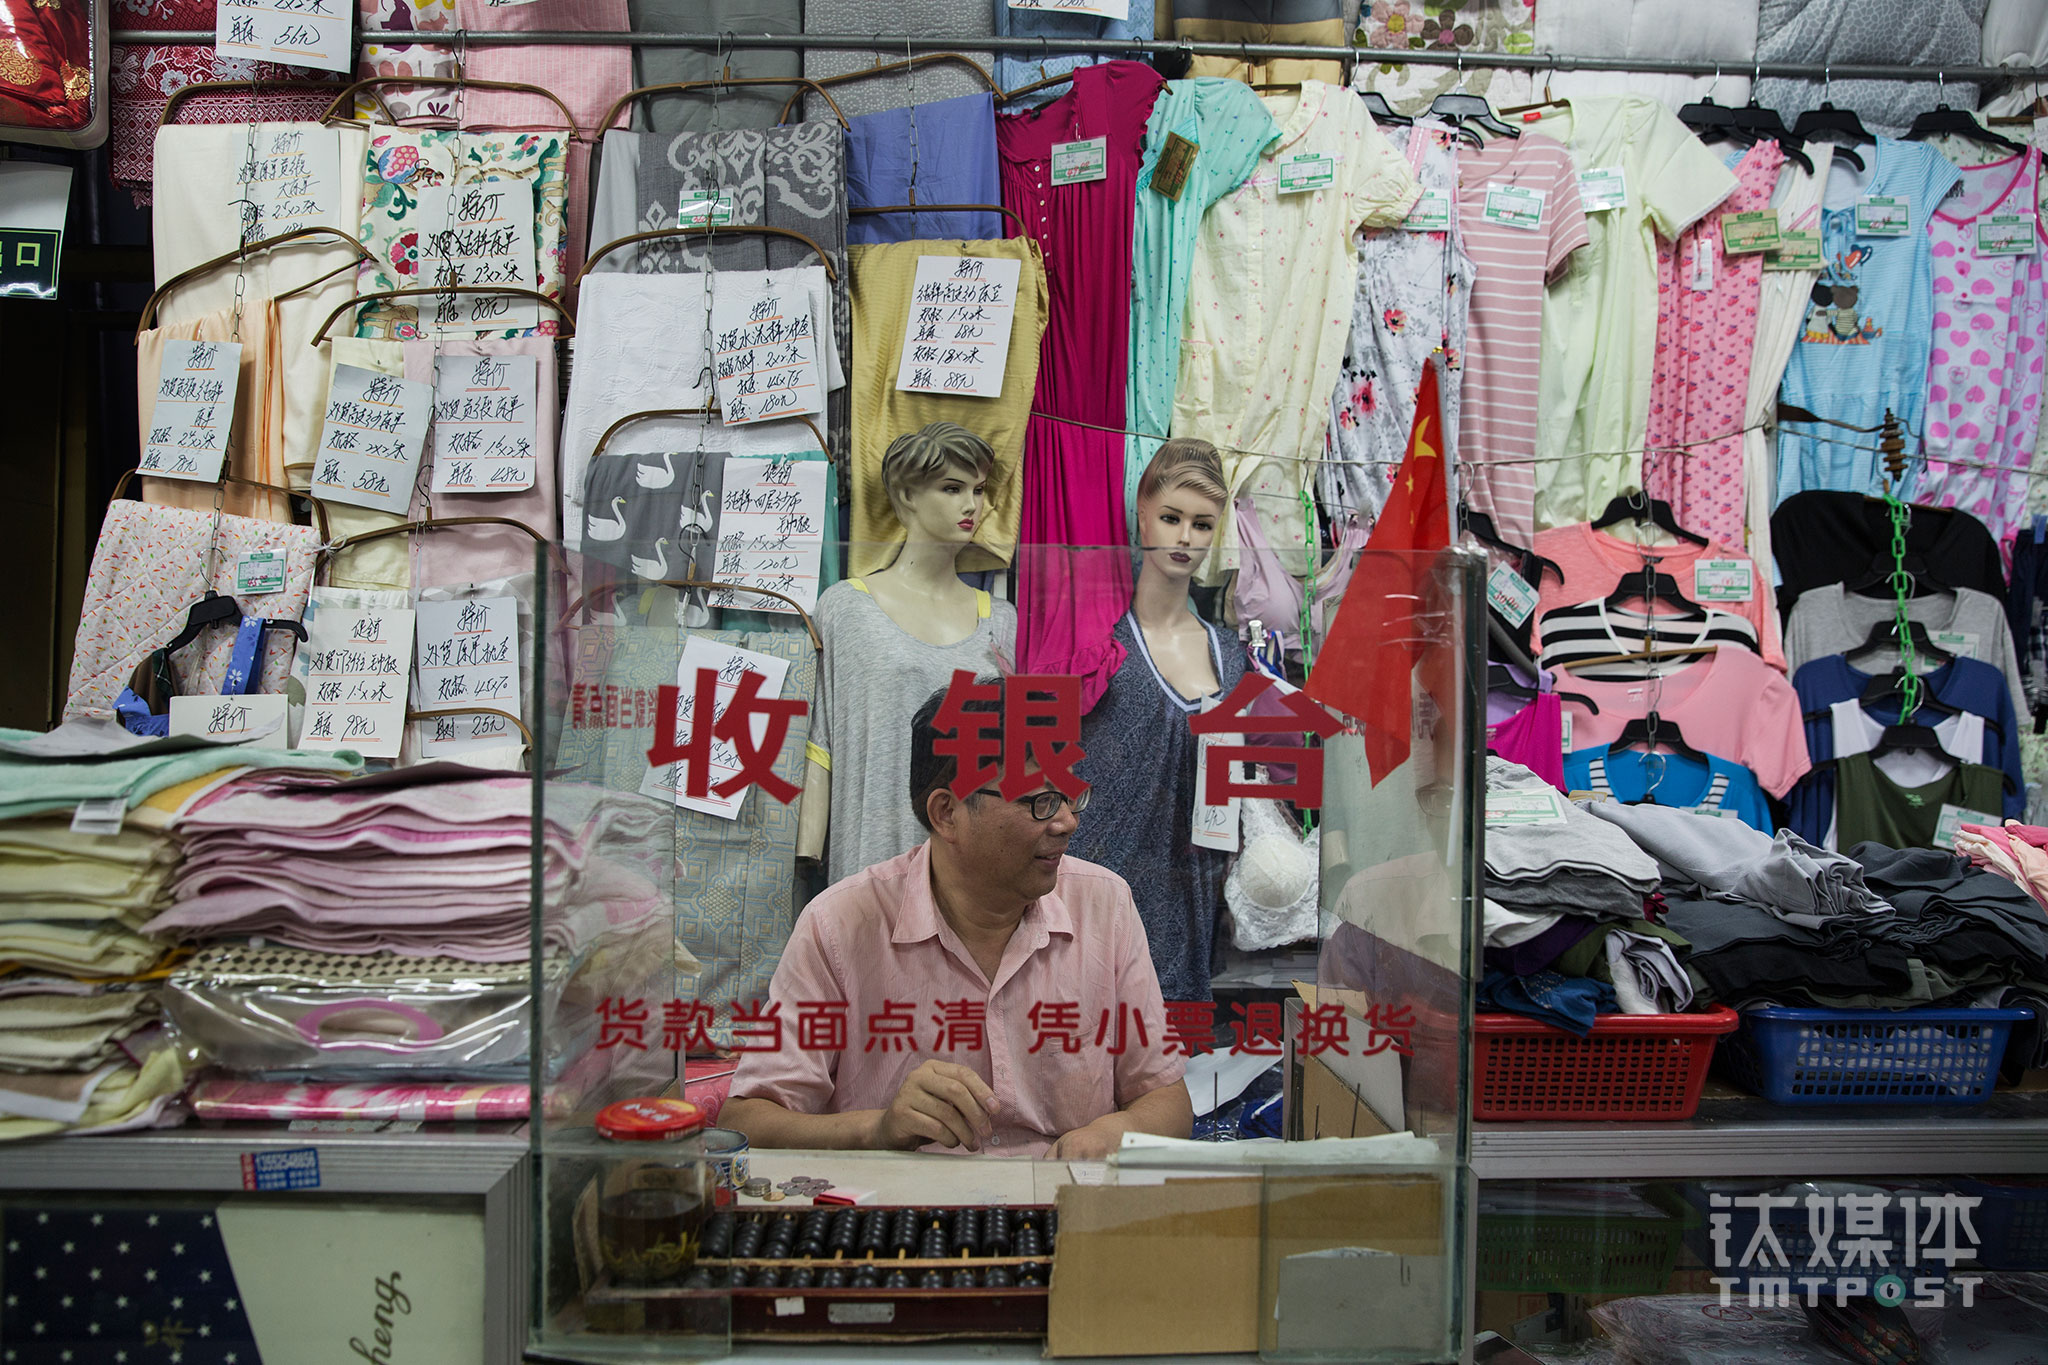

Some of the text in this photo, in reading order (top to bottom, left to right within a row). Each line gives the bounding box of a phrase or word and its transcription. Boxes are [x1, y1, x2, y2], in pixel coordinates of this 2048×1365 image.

[271, 130, 304, 154] 特价
[458, 189, 505, 223] 特价
[954, 258, 985, 281] 特价
[749, 297, 781, 321] 特价
[187, 342, 218, 369] 特价
[472, 357, 511, 391] 特价
[362, 377, 404, 407] 特价
[352, 617, 383, 643] 促销
[457, 601, 491, 634] 特价
[208, 703, 252, 734] 特价
[646, 667, 1347, 811] 收银台
[595, 998, 1417, 1057] 货款当面点清 凭小票退换货
